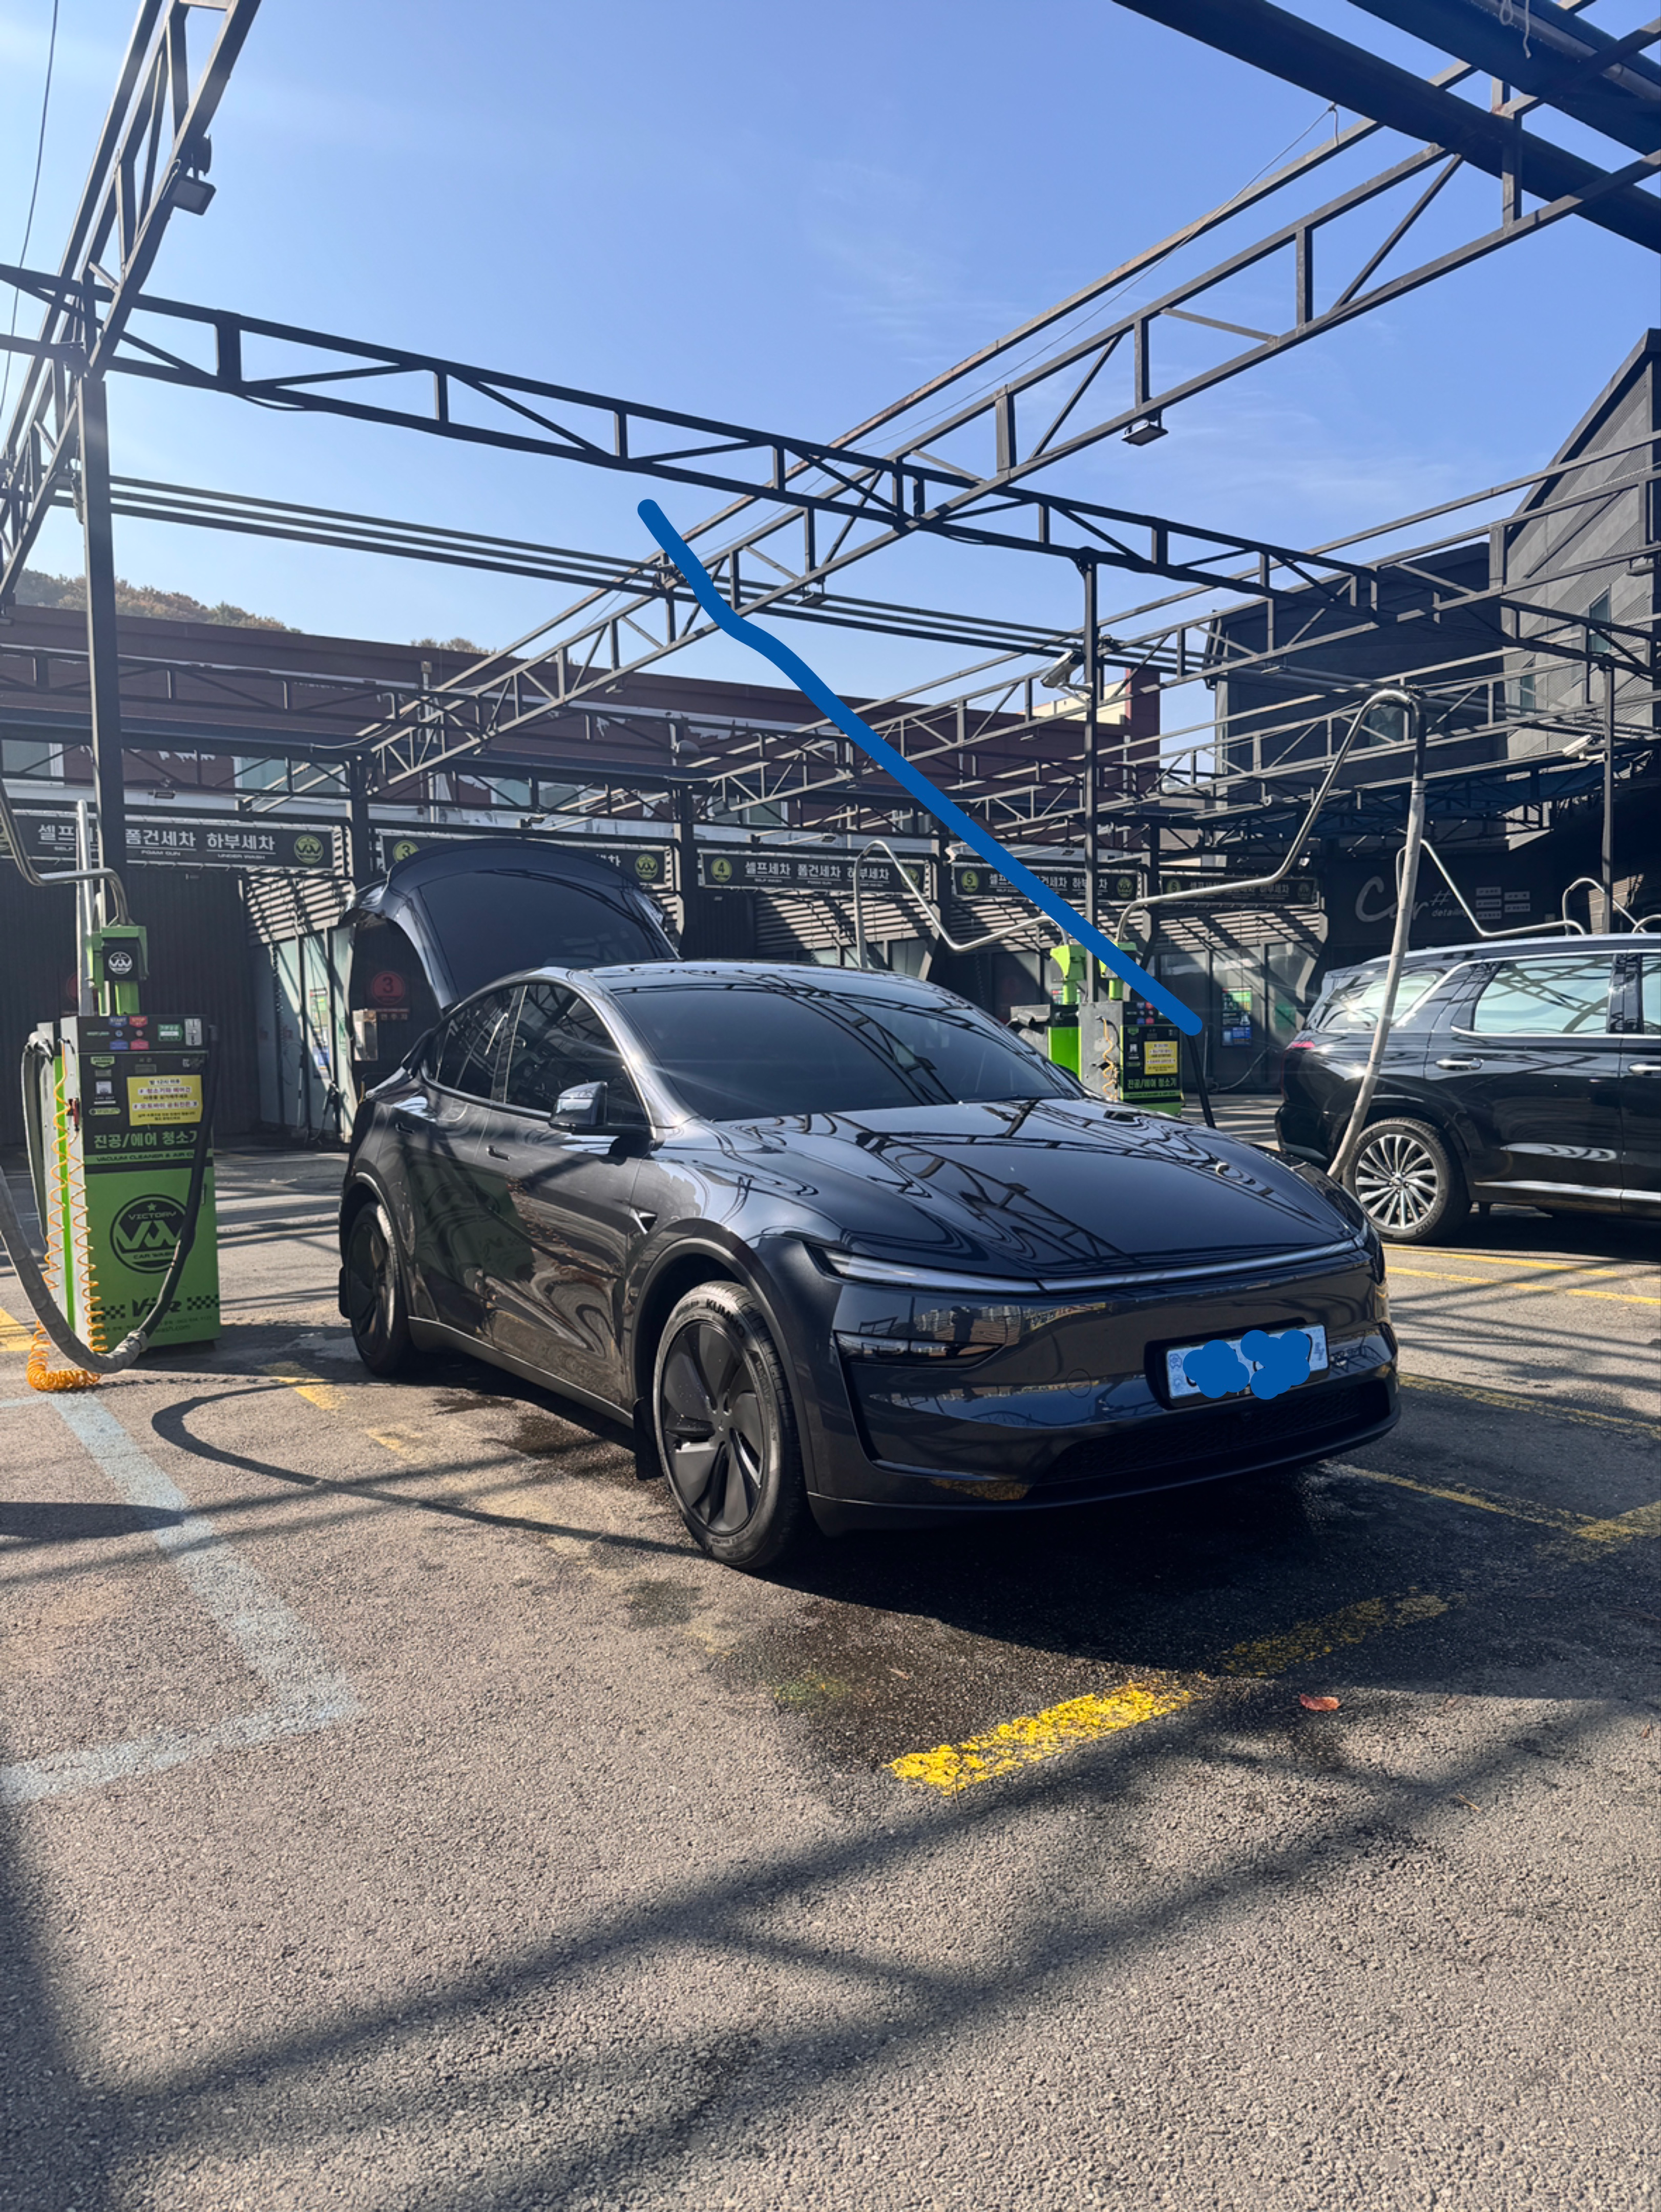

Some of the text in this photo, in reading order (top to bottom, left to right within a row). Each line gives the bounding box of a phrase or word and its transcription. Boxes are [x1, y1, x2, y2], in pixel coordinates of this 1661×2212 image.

[206, 833, 275, 851] 하부세차
[718, 862, 724, 873] 4
[746, 861, 791, 876] 셀프세차
[798, 864, 841, 878] 폼건세차
[966, 874, 973, 884] 5
[383, 976, 393, 993] 3
[94, 1132, 157, 1149] 진공/에어
[129, 1211, 177, 1221] VICTORY
[706, 1299, 745, 1338] KUMHO
